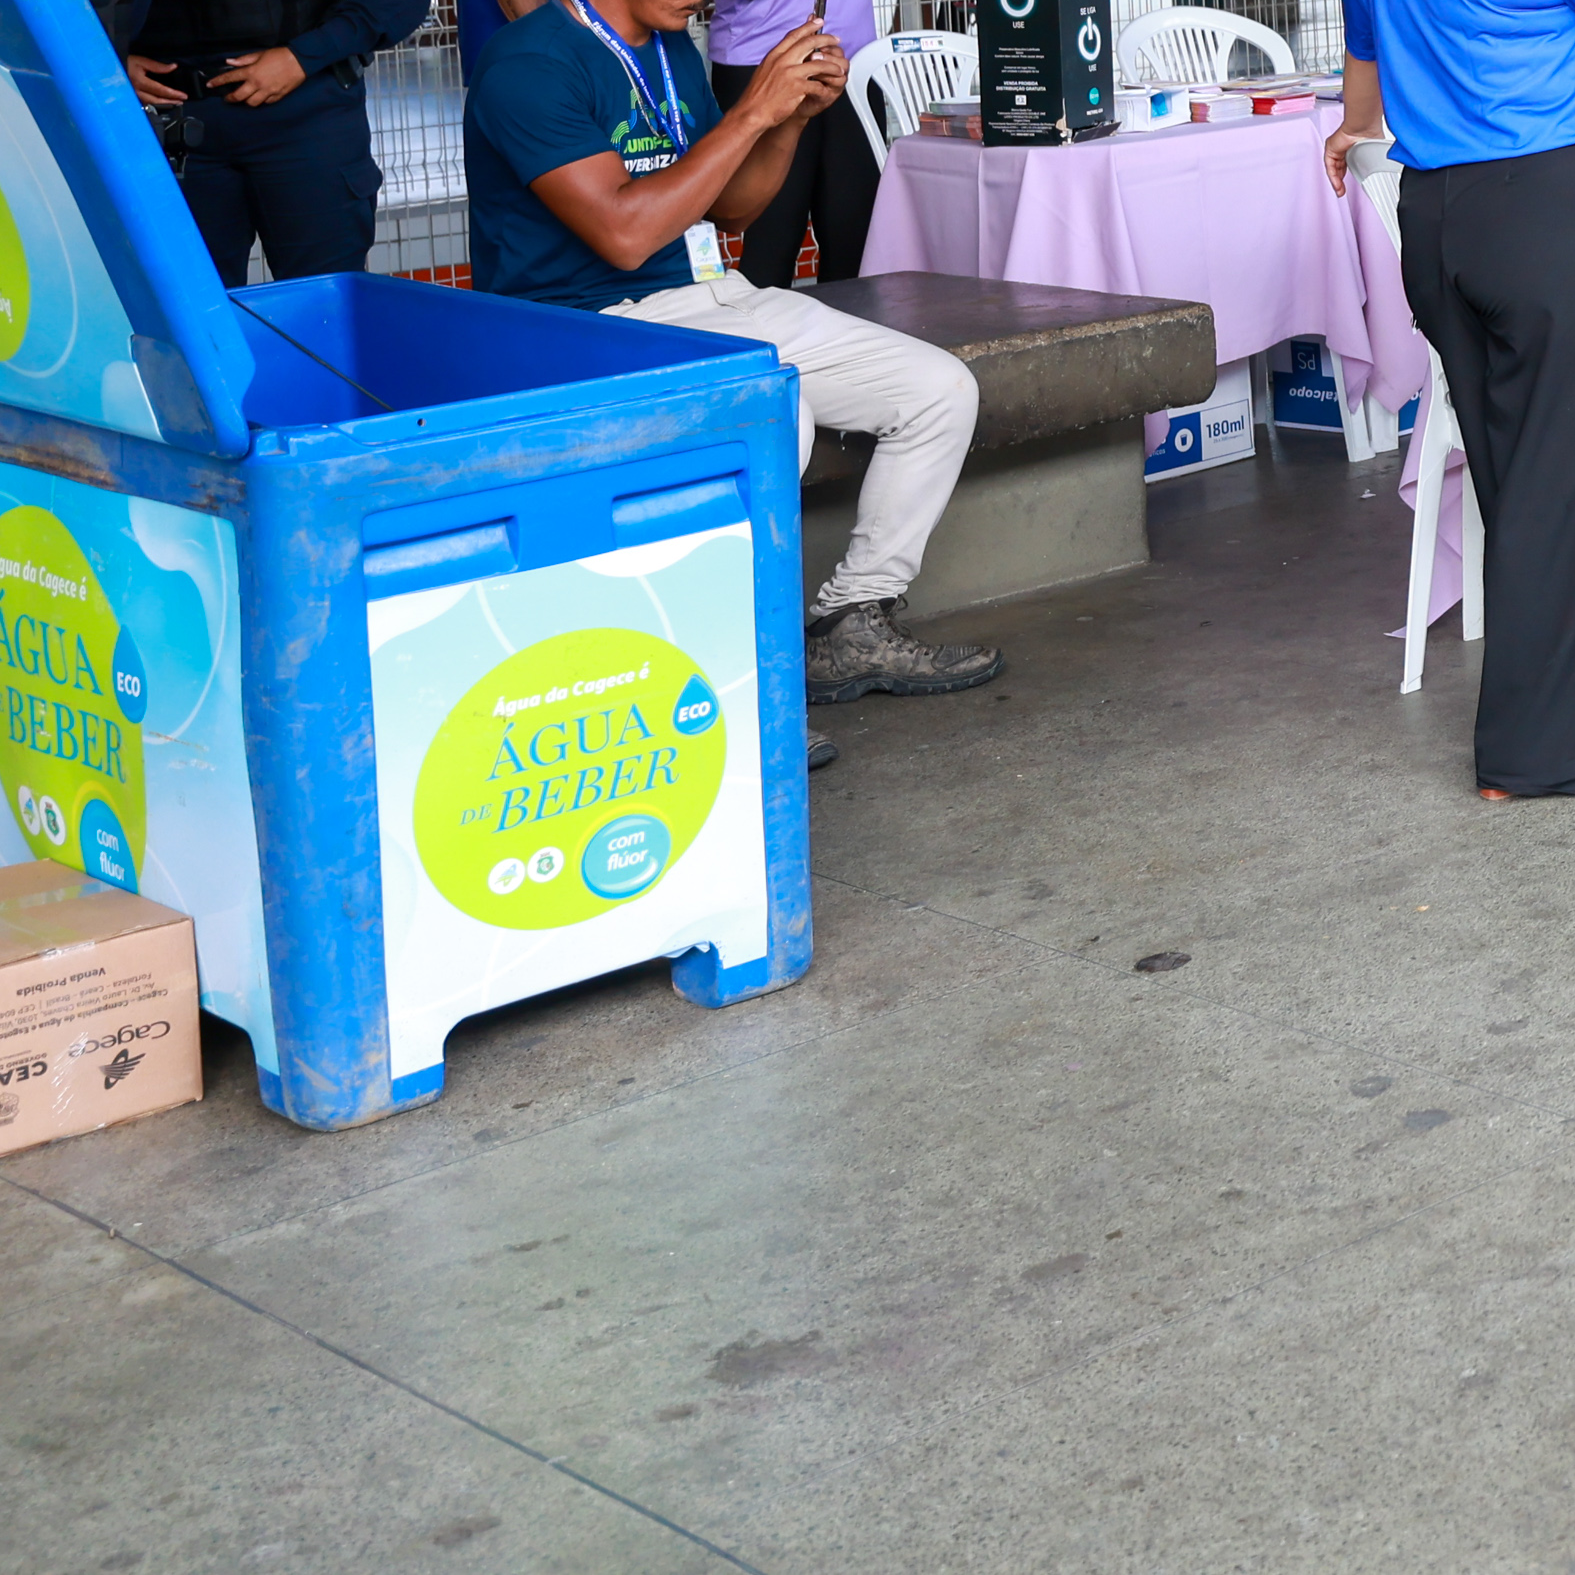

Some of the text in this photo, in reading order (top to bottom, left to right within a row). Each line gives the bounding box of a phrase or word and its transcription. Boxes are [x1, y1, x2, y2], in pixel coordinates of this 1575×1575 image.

[1012, 20, 1025, 29] USE
[593, 21, 611, 40] Fórum
[610, 38, 622, 52] das
[620, 49, 641, 78] Unidades
[1088, 64, 1097, 72] USE
[1297, 352, 1316, 371] PS
[1289, 387, 1340, 403] talcopo
[1206, 415, 1245, 438] 180ml
[0, 557, 87, 601] gua da Cagece é
[117, 671, 141, 698] ECO
[492, 661, 650, 718] Água da Cagece é
[677, 700, 711, 723] ECO
[6, 685, 126, 784] BEBER
[485, 703, 656, 782] ÁGUA
[459, 746, 681, 834] DE BEBER
[97, 828, 119, 853] com
[607, 831, 645, 852] com
[100, 851, 125, 882] flúor
[607, 849, 649, 872] flúor
[16, 967, 107, 997] Venda Proibida
[113, 972, 152, 988] Fortaleza
[46, 994, 71, 1007] Brasil
[77, 996, 101, 1007] Vieira
[79, 985, 105, 998] Ceará
[102, 990, 128, 1001] Lauro
[17, 1004, 36, 1015] CEP
[63, 1013, 76, 1022] de
[77, 999, 129, 1019] Companhia
[39, 1016, 63, 1029] Água
[68, 1020, 171, 1058] Cagece
[6, 1052, 48, 1068] GOVERNO
[0, 1061, 48, 1086] CEA
